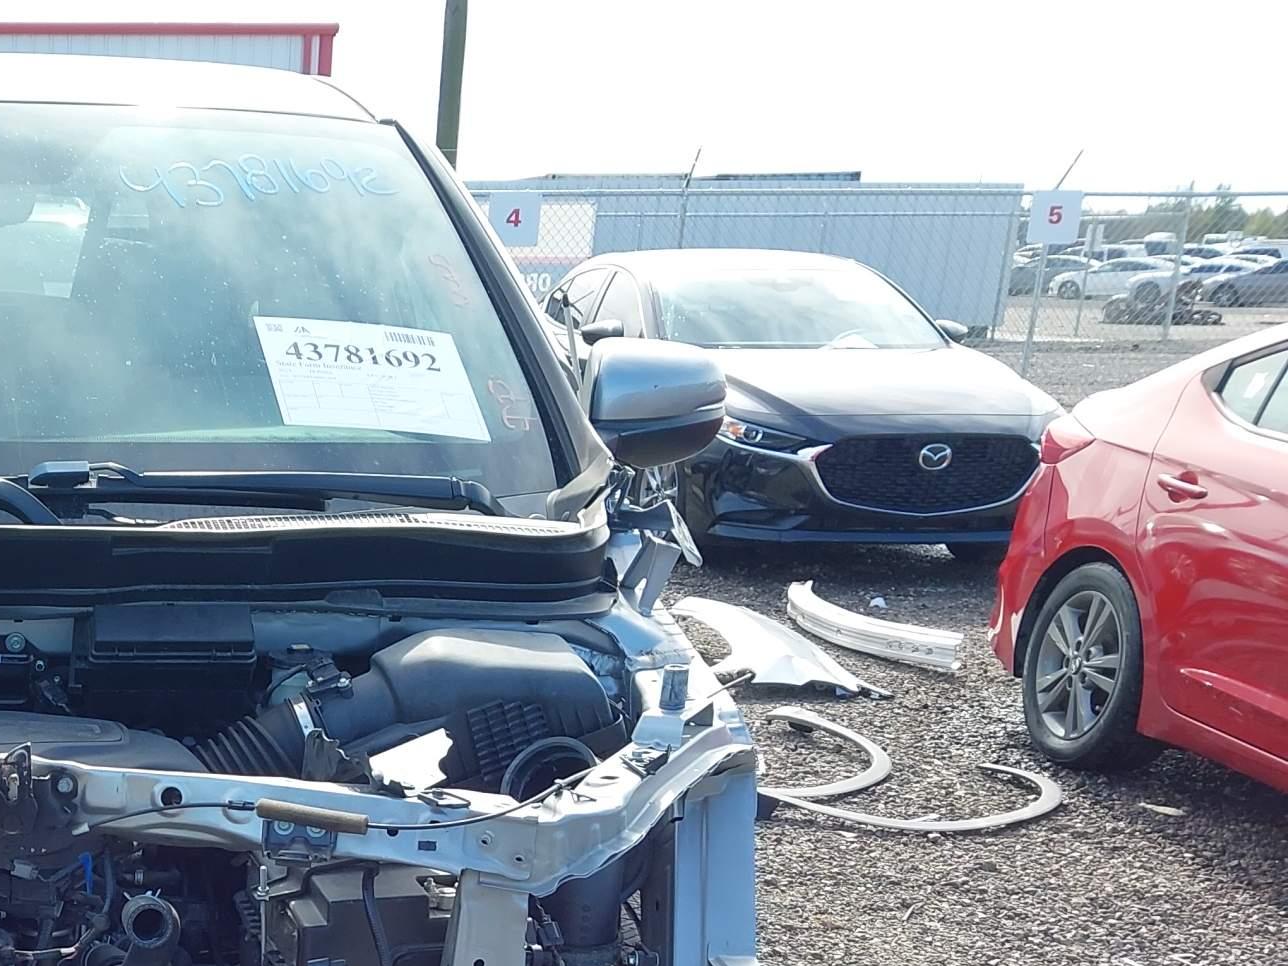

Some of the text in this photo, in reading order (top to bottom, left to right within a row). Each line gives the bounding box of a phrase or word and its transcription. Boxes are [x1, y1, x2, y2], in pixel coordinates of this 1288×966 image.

[506, 208, 522, 228] 4
[1048, 205, 1063, 225] 5
[285, 341, 441, 372] 43781692
